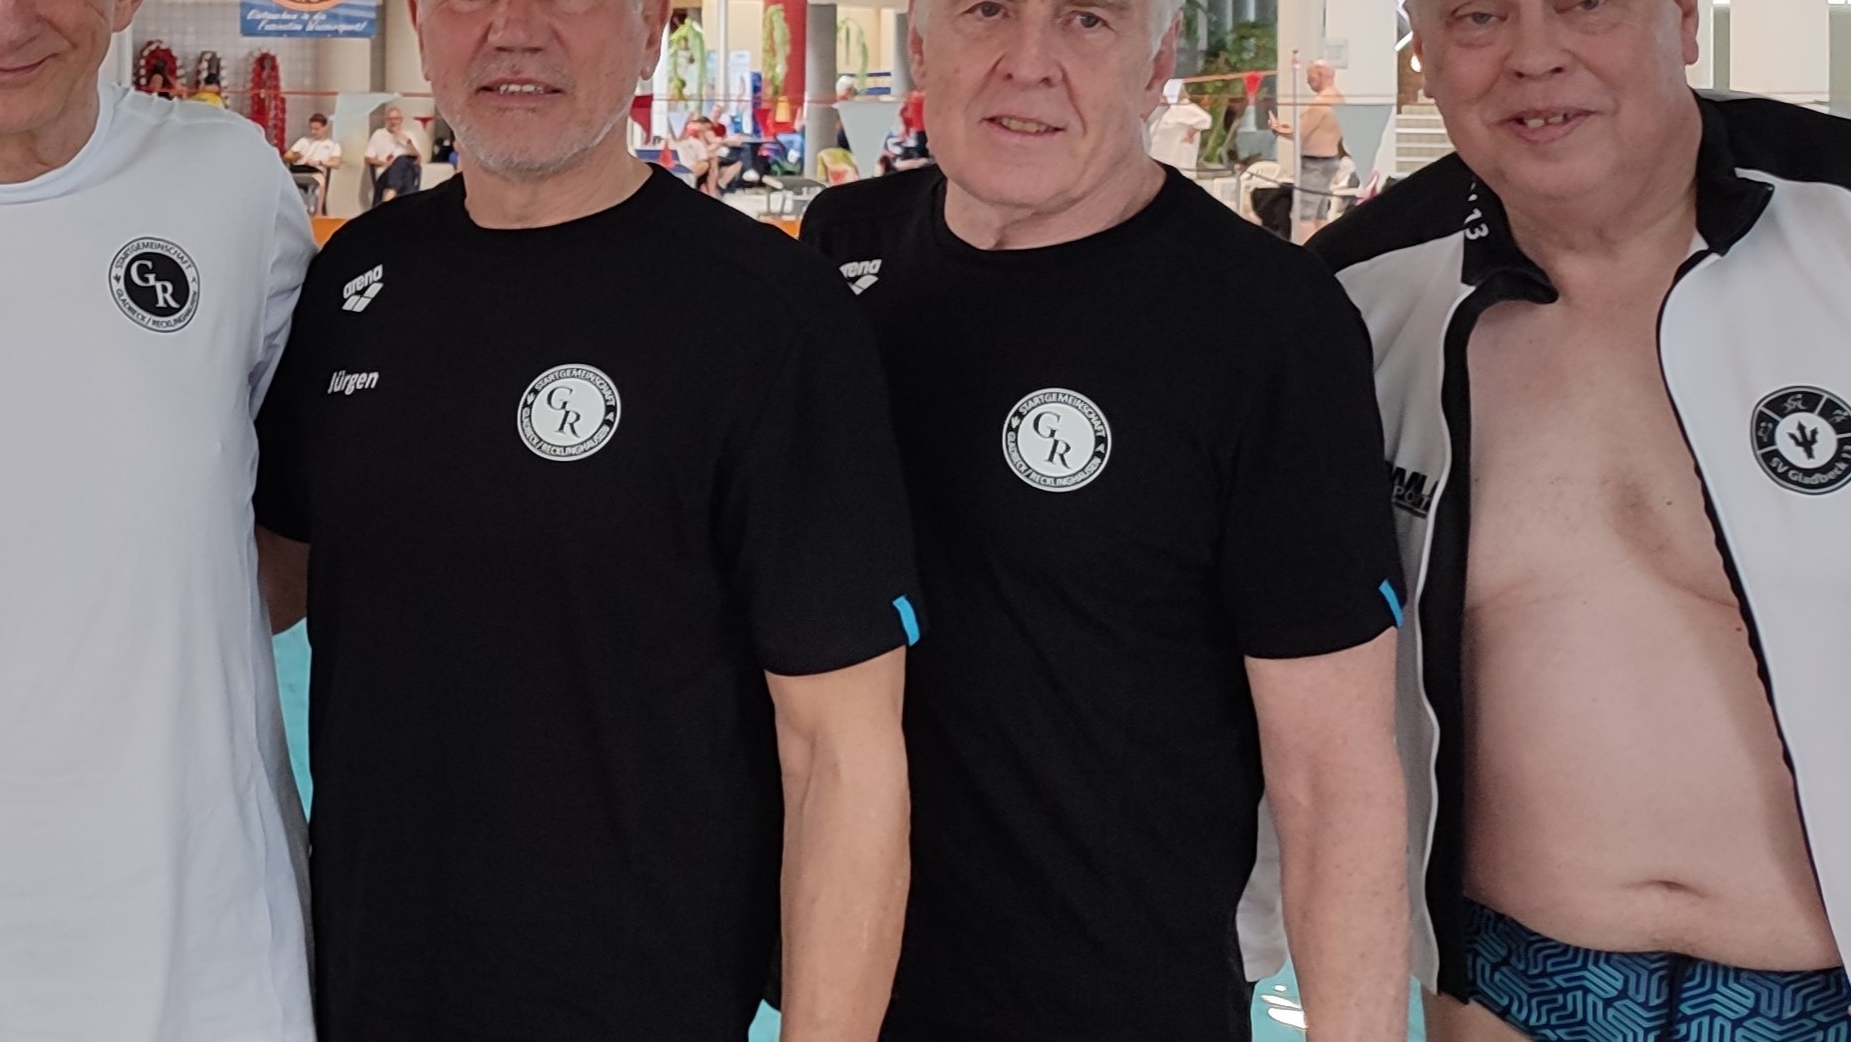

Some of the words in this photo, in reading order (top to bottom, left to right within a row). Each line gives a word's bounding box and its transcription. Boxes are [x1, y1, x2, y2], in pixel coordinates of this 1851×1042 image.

[343, 264, 383, 299] arena
[838, 258, 883, 279] rena
[327, 370, 380, 396] Jürgen
